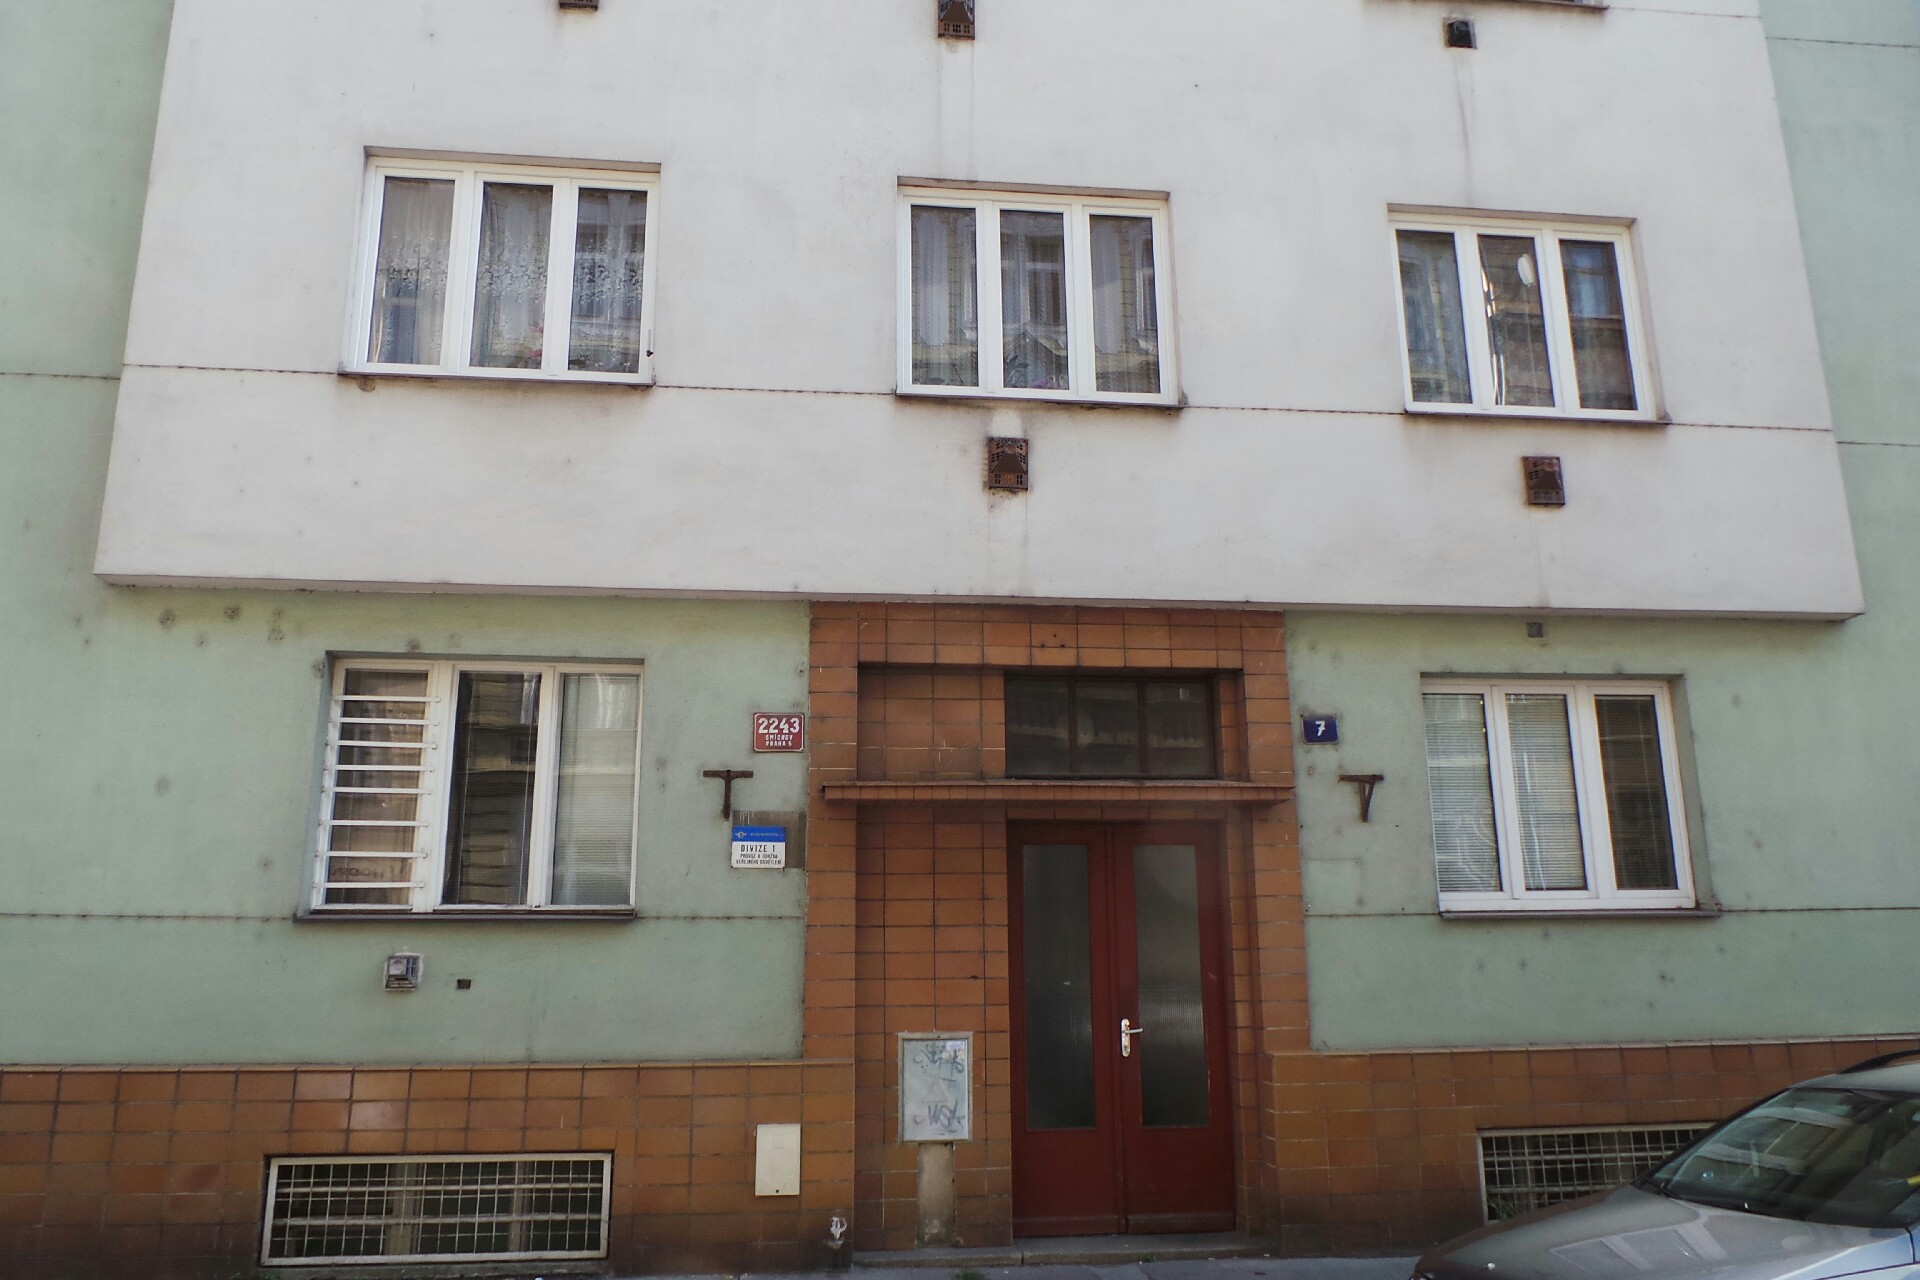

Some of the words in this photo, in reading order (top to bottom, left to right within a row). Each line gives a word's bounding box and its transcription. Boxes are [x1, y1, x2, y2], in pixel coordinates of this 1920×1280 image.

[758, 717, 800, 734] 2243
[1315, 720, 1326, 737] 7
[740, 844, 767, 852] DIVIZE
